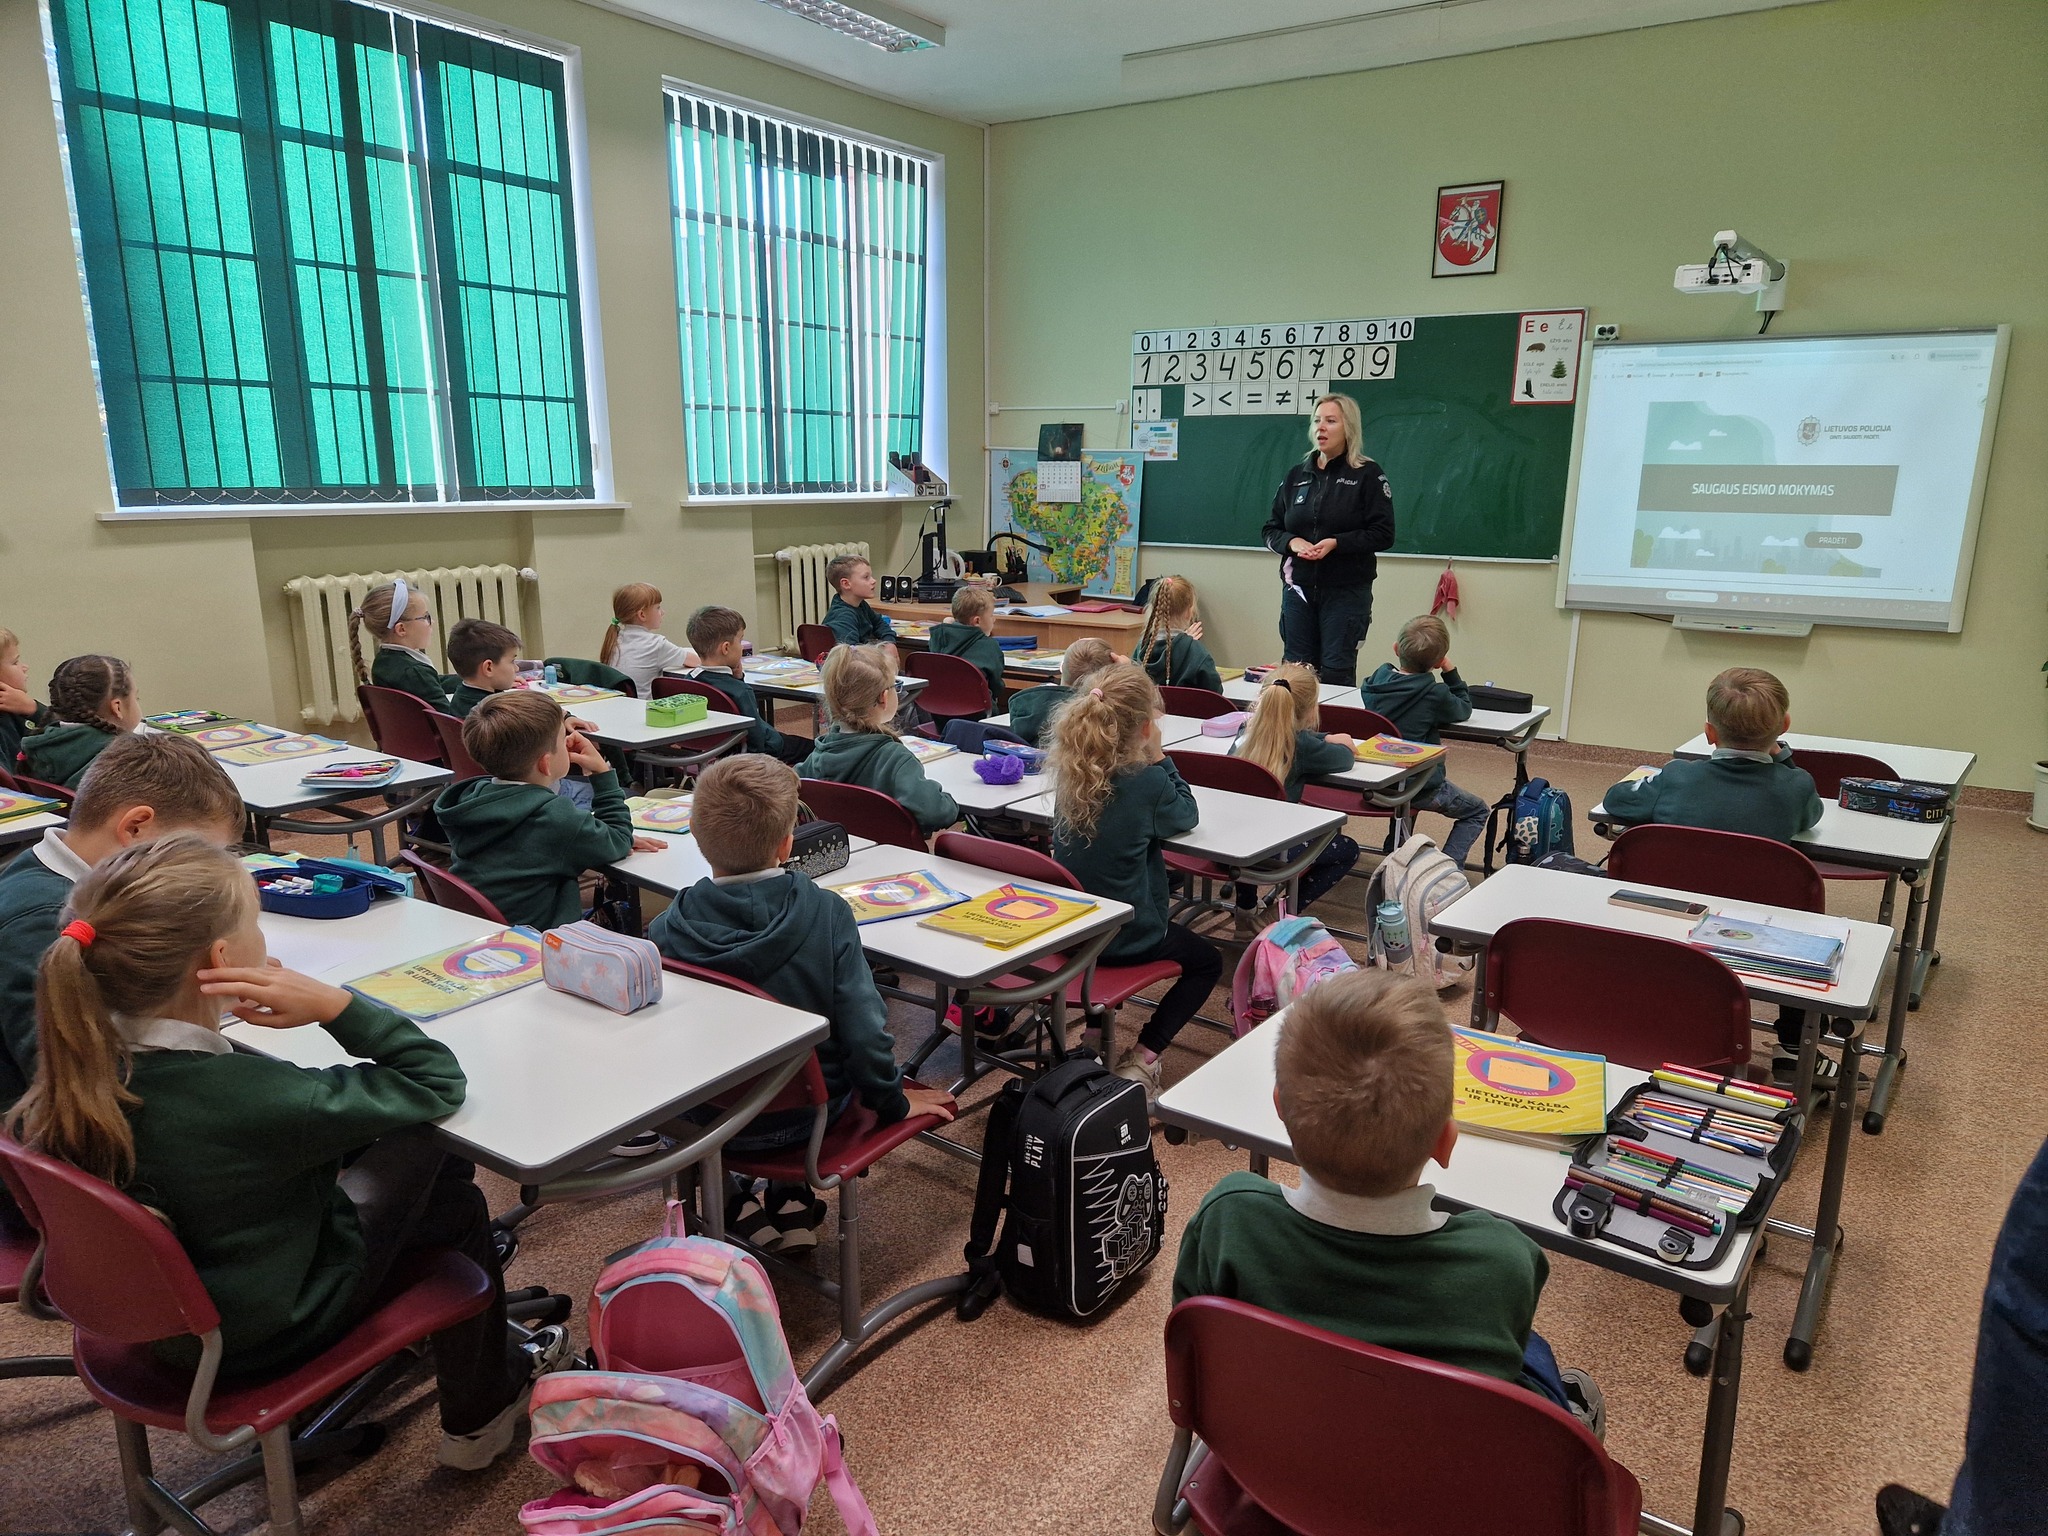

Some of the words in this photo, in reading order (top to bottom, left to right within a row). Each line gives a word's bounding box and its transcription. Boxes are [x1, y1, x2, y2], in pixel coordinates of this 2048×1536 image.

[1525, 320, 1535, 333] E
[1540, 322, 1549, 332] e
[1141, 335, 1151, 352] 0
[1164, 334, 1171, 351] 1
[1187, 332, 1197, 349] 2
[1211, 331, 1221, 348] 3
[1235, 329, 1246, 347] 4
[1260, 328, 1271, 346] 5
[1286, 327, 1297, 344] 6
[1313, 326, 1324, 343] 7
[1339, 324, 1350, 342] 8
[1366, 323, 1378, 341] 9
[1388, 320, 1412, 340] 10
[1141, 355, 1151, 383] 1
[1164, 354, 1181, 383] 2
[1190, 353, 1207, 381] 3
[1219, 352, 1236, 380] 4
[1247, 350, 1265, 380] 5
[1276, 349, 1295, 379] 6
[1308, 348, 1325, 379] 7
[1337, 347, 1356, 378] 8
[1369, 346, 1390, 377] 9
[1859, 424, 1892, 432] POLICIJA
[1692, 483, 1740, 495] SAUGAUS
[1741, 483, 1776, 496] EISMO
[1778, 484, 1835, 496] MOKYMAS
[1926, 808, 1944, 819] CITY
[1464, 1087, 1523, 1104] LIETUVIŲ
[1527, 1100, 1570, 1109] KALBA
[1485, 1098, 1564, 1113] LITERATŪRA
[1030, 1136, 1045, 1169] PLAY
